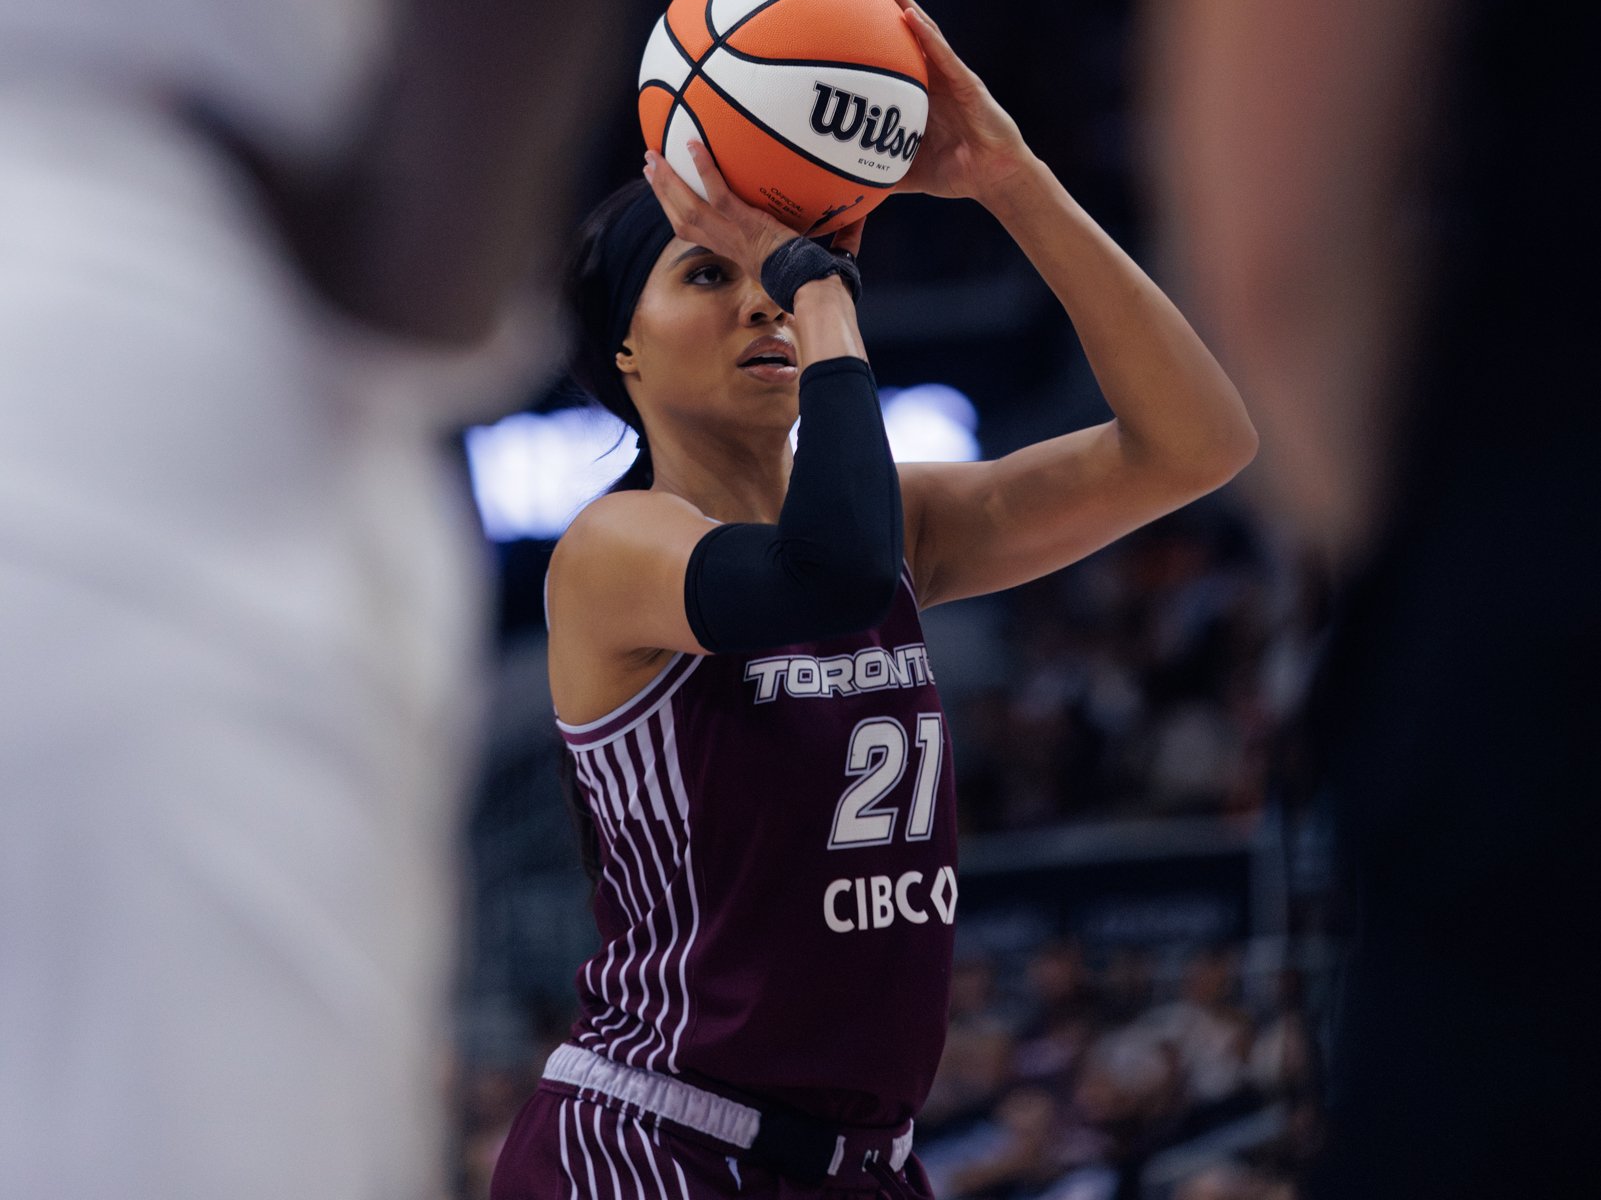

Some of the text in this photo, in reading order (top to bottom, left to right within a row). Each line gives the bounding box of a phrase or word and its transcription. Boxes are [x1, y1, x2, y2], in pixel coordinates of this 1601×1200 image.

[858, 158, 890, 172] EVO NXT
[827, 712, 944, 850] 21
[823, 870, 930, 933] CIBC
